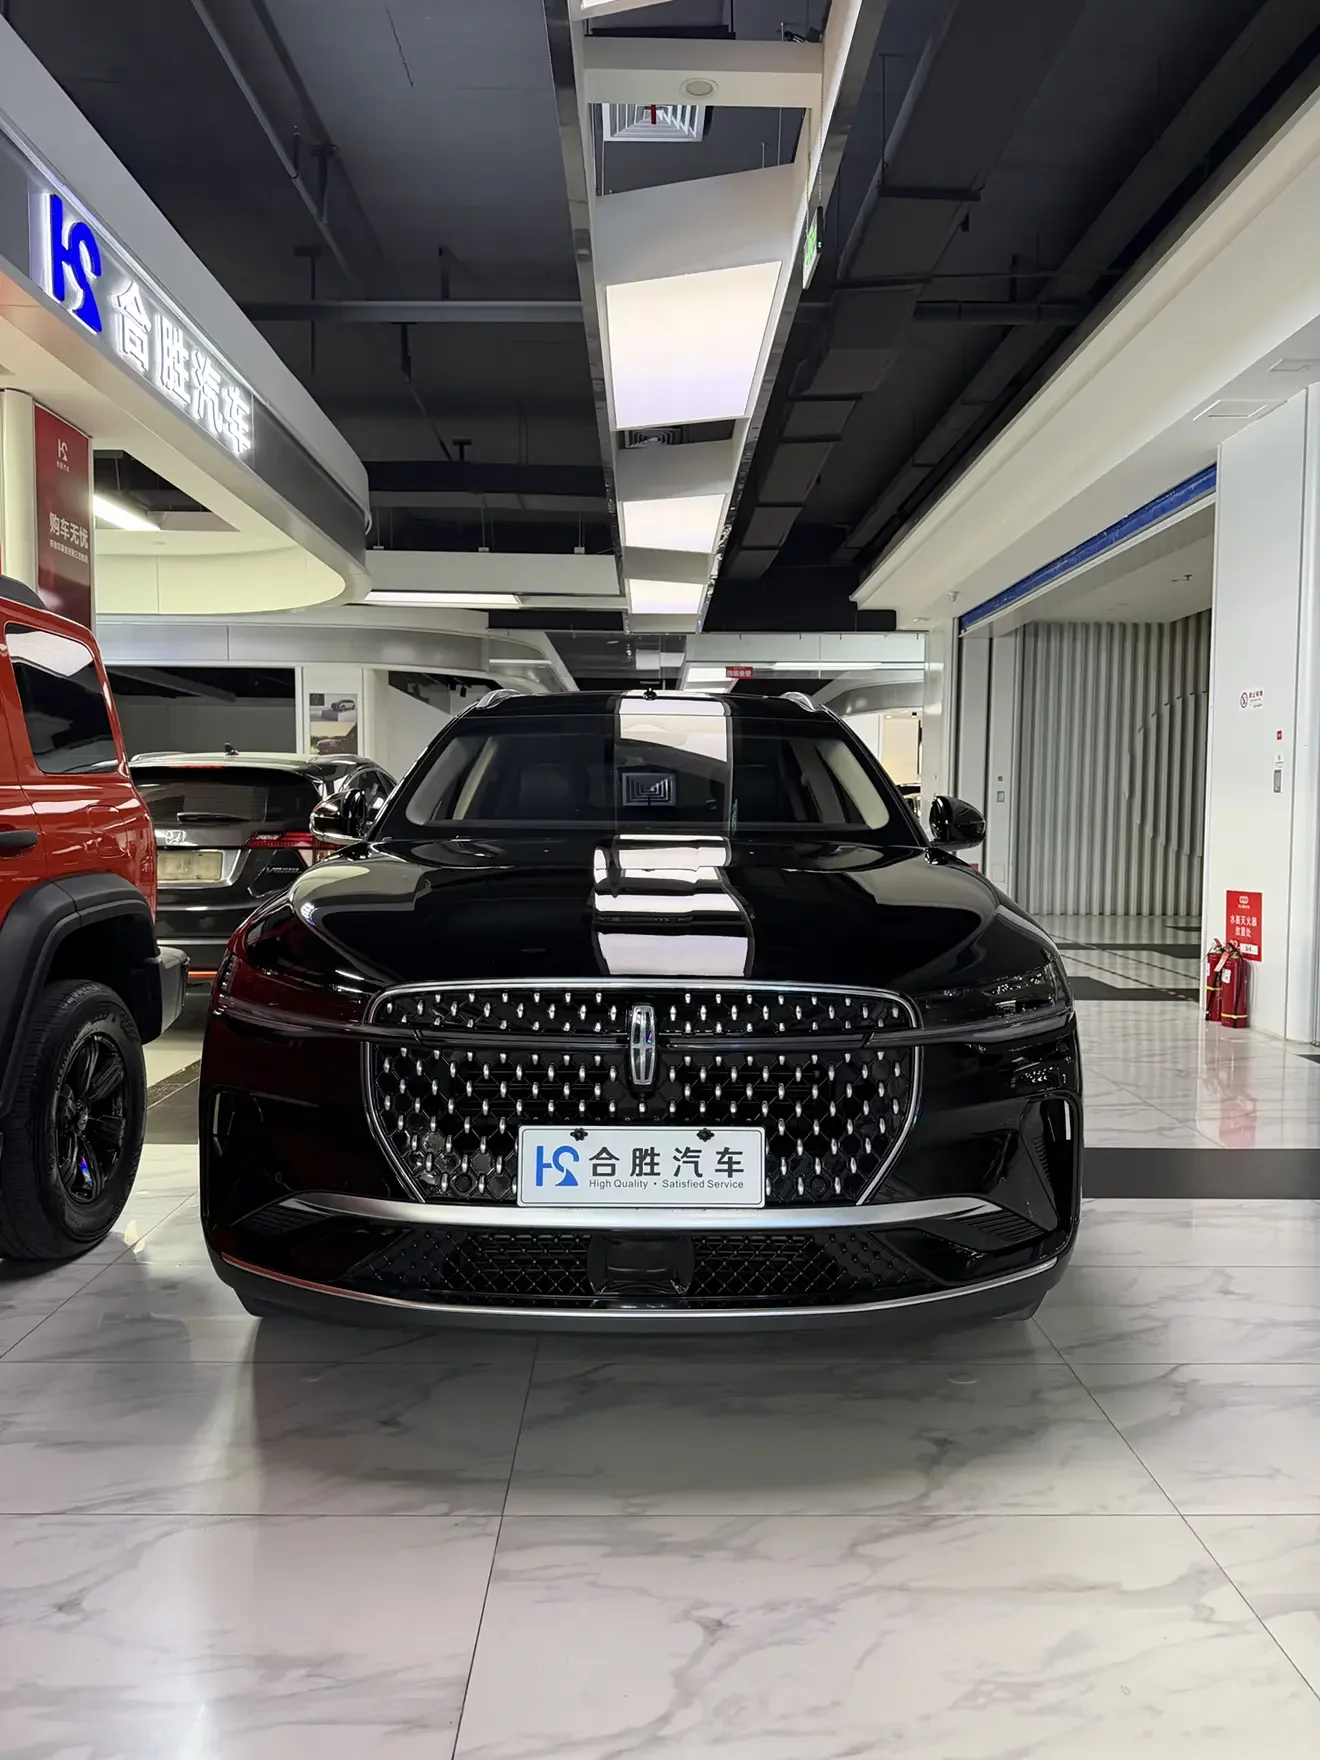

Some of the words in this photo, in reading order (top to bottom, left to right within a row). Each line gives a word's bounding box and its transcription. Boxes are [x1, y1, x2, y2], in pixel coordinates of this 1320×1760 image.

[113, 279, 252, 455] 合胜汽车
[49, 511, 89, 549] 购车无忧
[588, 1146, 745, 1178] 合胜汽车
[589, 1179, 612, 1190] High
[613, 1179, 649, 1190] Quality
[662, 1179, 705, 1189] Satisfied
[707, 1179, 744, 1189] Service
